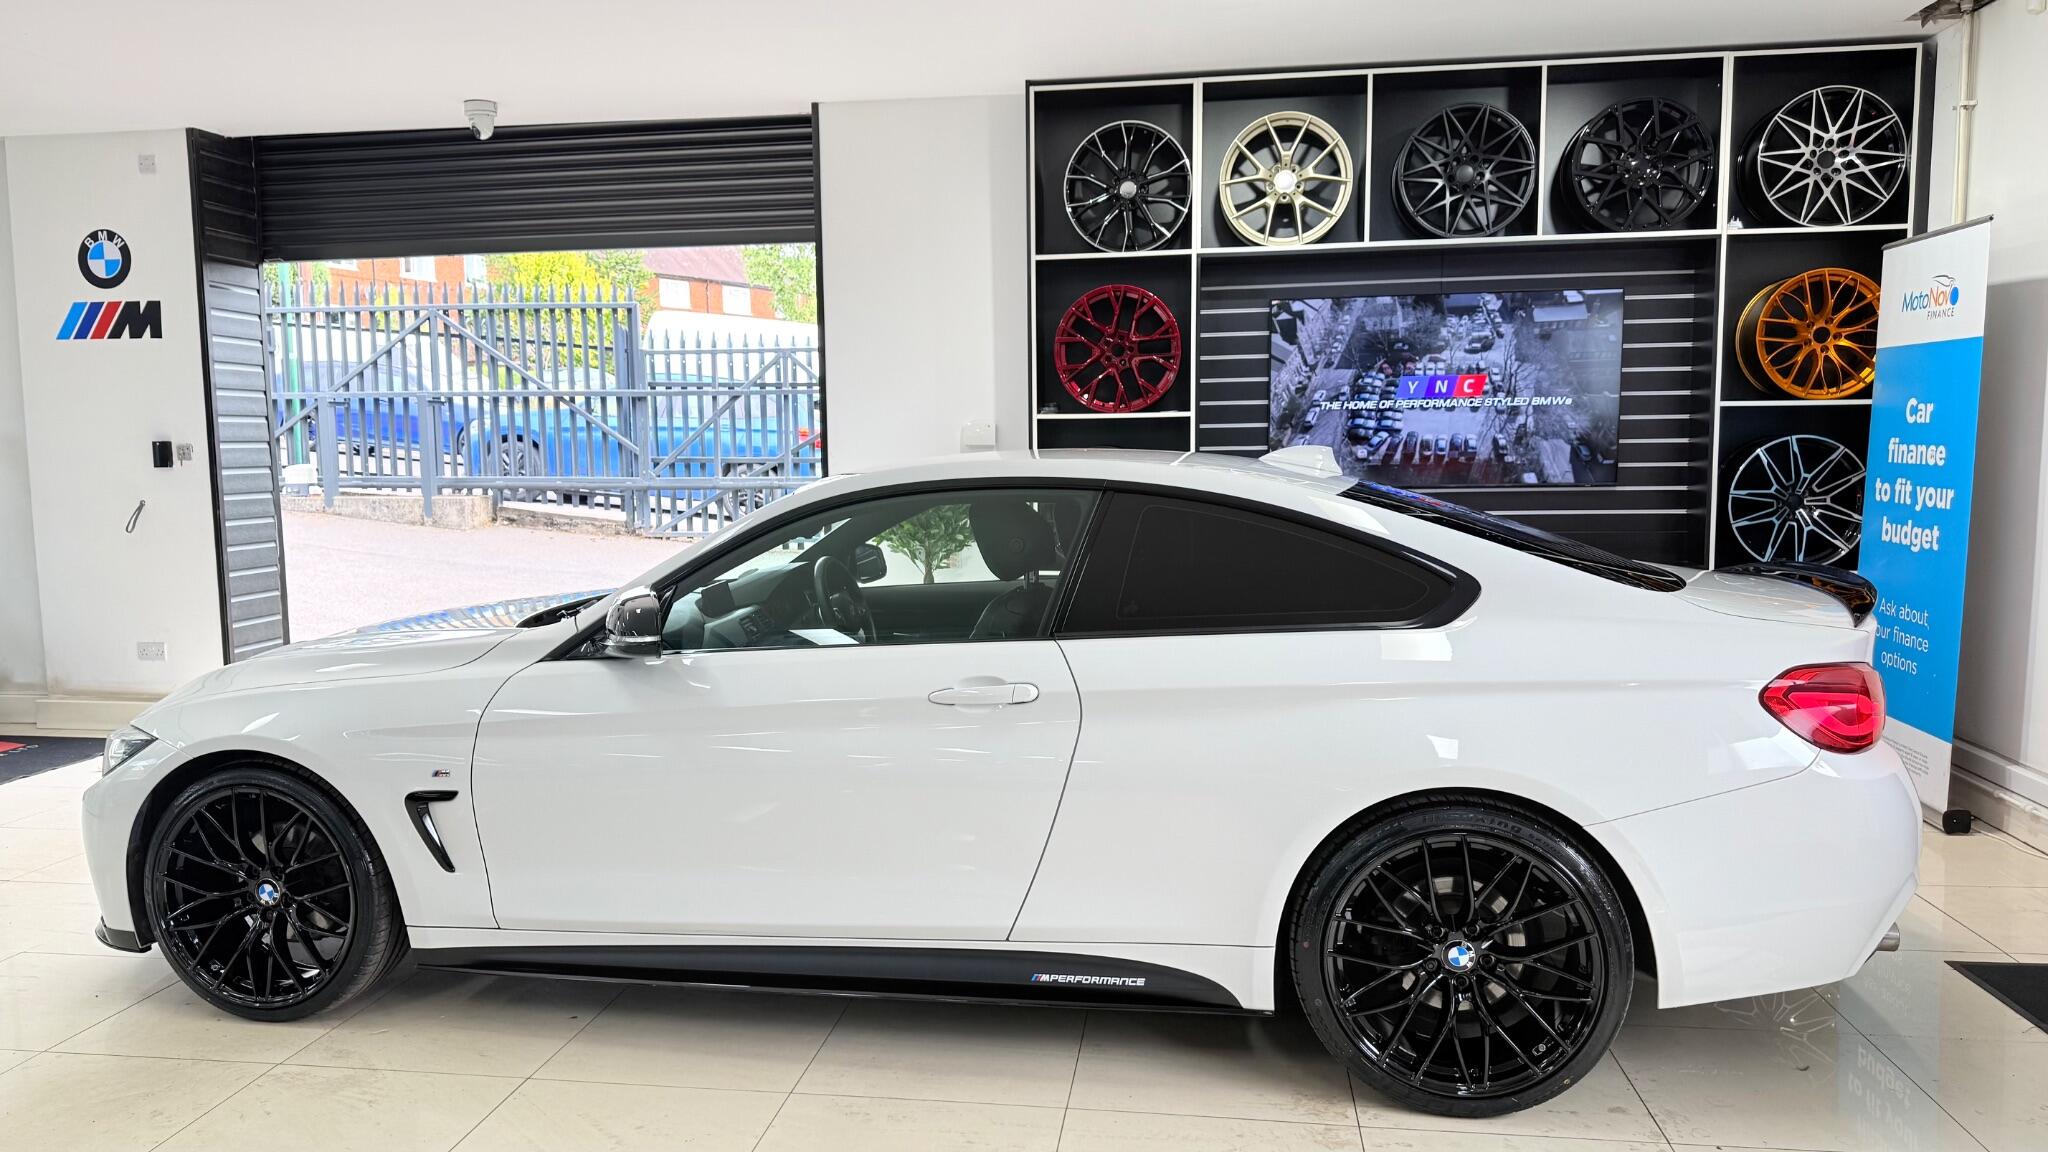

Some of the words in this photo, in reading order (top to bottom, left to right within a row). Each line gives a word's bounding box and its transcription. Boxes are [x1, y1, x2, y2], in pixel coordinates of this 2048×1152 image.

[84, 230, 125, 249] BMW
[1927, 307, 1955, 320] FINANCE
[1320, 401, 1342, 411] THE
[1343, 400, 1378, 410] HOME
[1379, 399, 1394, 409] OF
[1395, 397, 1483, 409] PERFORMANCE
[1484, 397, 1530, 407] STYLED
[1531, 396, 1573, 406] BMWs
[1905, 397, 1934, 424] Car
[1887, 437, 1946, 466] finance
[1875, 477, 1891, 502] to
[1894, 477, 1913, 505] fit
[1914, 484, 1955, 512] your
[1881, 515, 1940, 552] budget
[1878, 597, 1897, 617] Ask
[1899, 602, 1929, 627] about
[1893, 625, 1929, 653] finance
[1881, 650, 1918, 676] options
